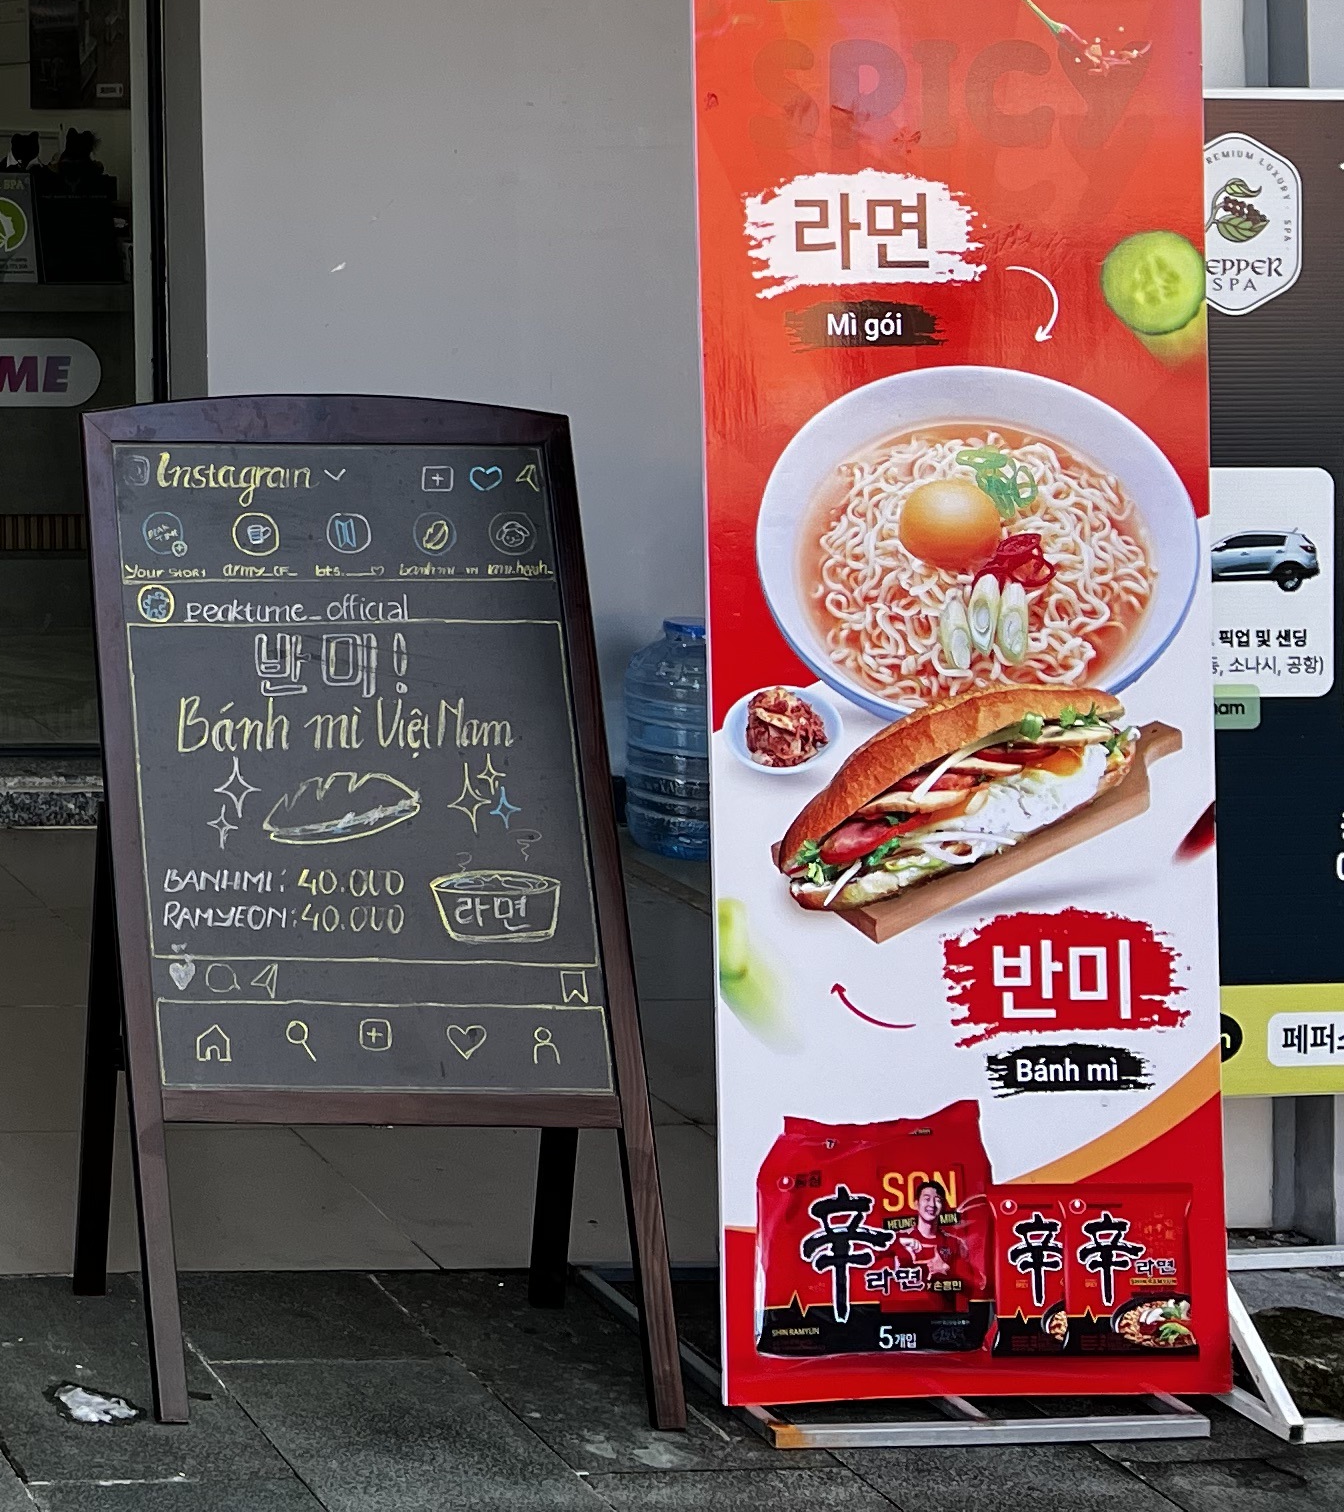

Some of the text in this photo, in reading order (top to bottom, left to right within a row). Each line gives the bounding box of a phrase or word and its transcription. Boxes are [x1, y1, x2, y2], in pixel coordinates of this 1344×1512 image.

[748, 38, 1154, 151] SPICY
[794, 192, 930, 270] 라면
[1206, 257, 1283, 277] EPPER
[1212, 278, 1257, 292] SPA
[827, 311, 902, 342] Mì gói
[157, 452, 312, 507] Instagram
[125, 564, 164, 578] Your
[1219, 629, 1250, 648] 픽업
[1256, 629, 1271, 648] 및
[1229, 655, 1281, 676] 소나시,
[1287, 655, 1324, 675] 공항)
[177, 694, 515, 758] Bánh mì Việt Nam
[298, 868, 405, 896] 40.000
[301, 904, 405, 934] 40.000
[454, 895, 531, 931] 라면
[993, 938, 1131, 1020] 반미
[1016, 1057, 1118, 1083] Bánh mì
[887, 1213, 958, 1229] HEUNG MIN
[800, 1183, 896, 1324] 辛
[1008, 1211, 1064, 1307] 辛
[1077, 1211, 1146, 1307] 辛
[1135, 1258, 1176, 1276] 라면
[865, 1267, 926, 1296] 라면
[878, 1325, 917, 1349] 5개입
